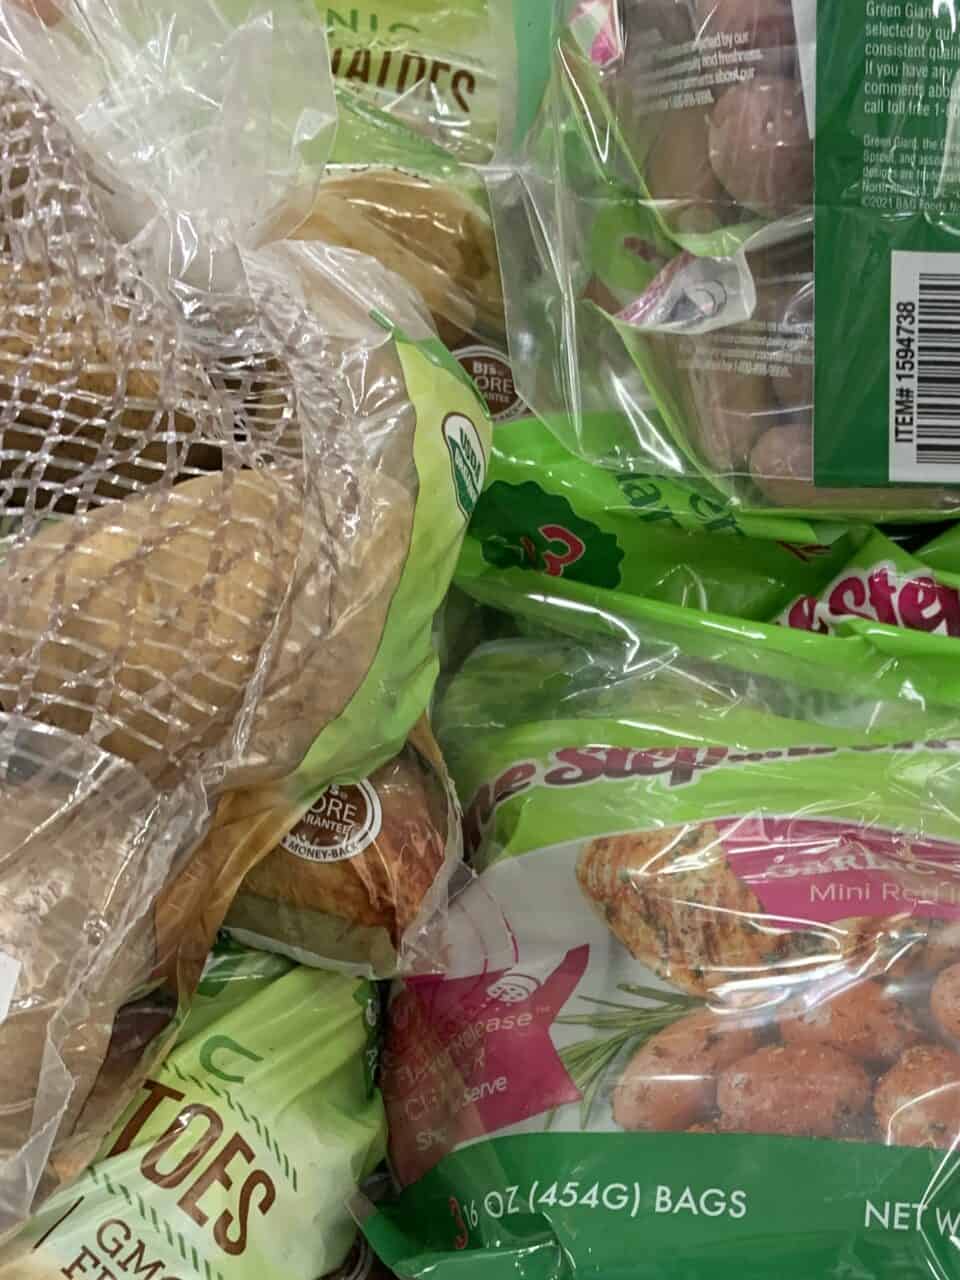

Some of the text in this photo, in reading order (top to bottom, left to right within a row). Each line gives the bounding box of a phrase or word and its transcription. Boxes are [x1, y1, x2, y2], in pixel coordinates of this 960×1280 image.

[866, 1, 901, 17] Green
[865, 21, 914, 39] selected
[918, 26, 931, 41] by
[865, 43, 927, 59] consistent
[865, 62, 873, 76] If
[876, 63, 899, 79] you
[902, 63, 929, 79] have
[864, 80, 925, 97] comments
[864, 99, 884, 114] call
[895, 301, 915, 443] ITEM# 1594738
[810, 884, 871, 902] Mini
[484, 1186, 520, 1218] OZ
[529, 1181, 642, 1217] (454G)
[655, 1185, 748, 1218] BAGS
[865, 1201, 928, 1231] NET
